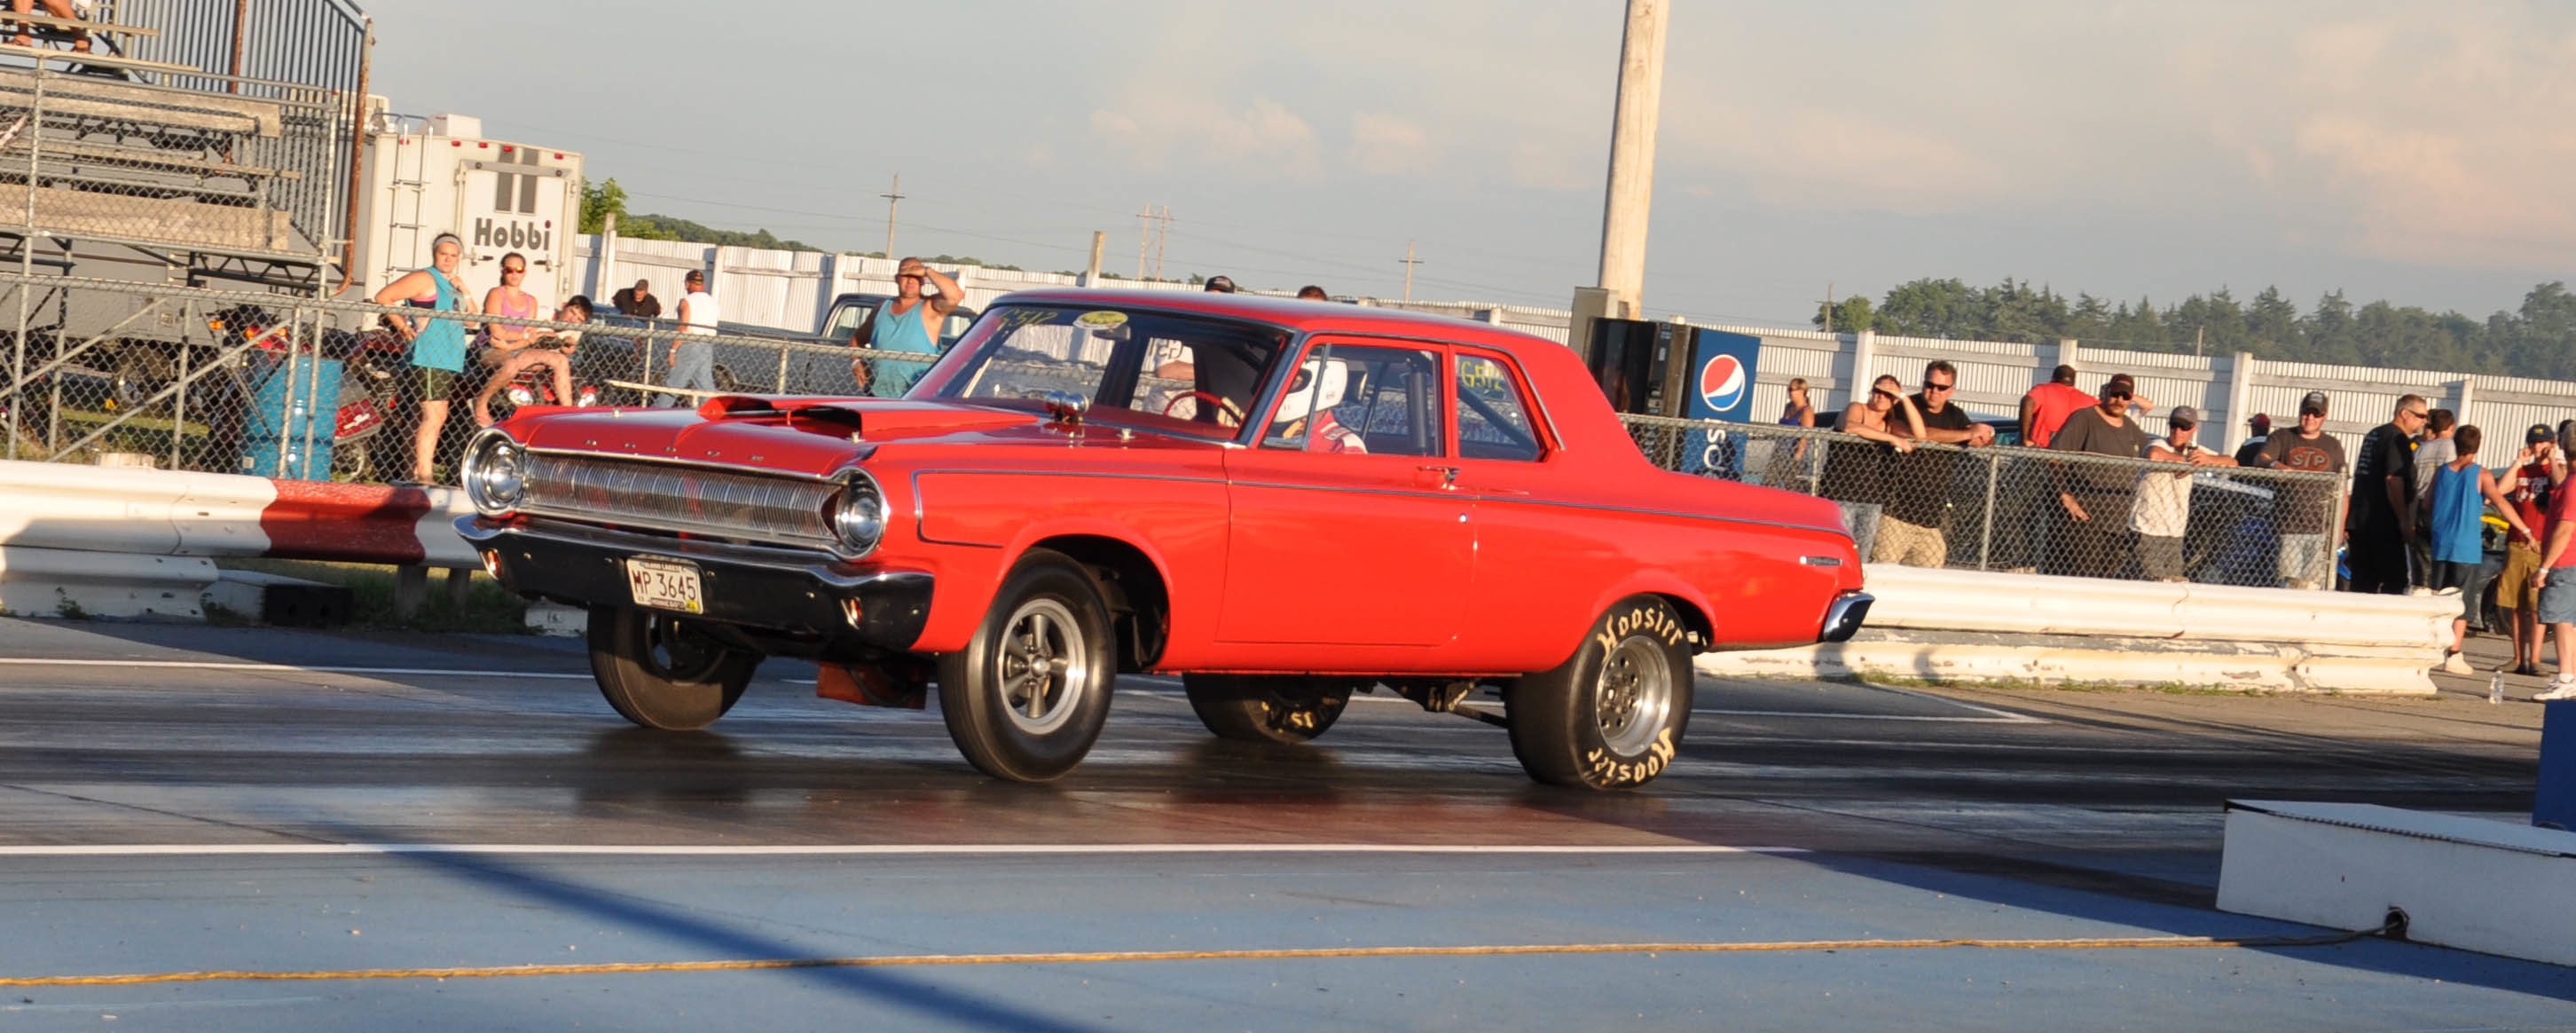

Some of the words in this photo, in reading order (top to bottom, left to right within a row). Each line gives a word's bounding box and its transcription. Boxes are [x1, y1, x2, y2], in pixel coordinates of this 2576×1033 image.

[474, 217, 551, 251] Hobbi
[2291, 450, 2326, 469] STP
[632, 570, 652, 595] MP
[656, 572, 696, 601] 3645
